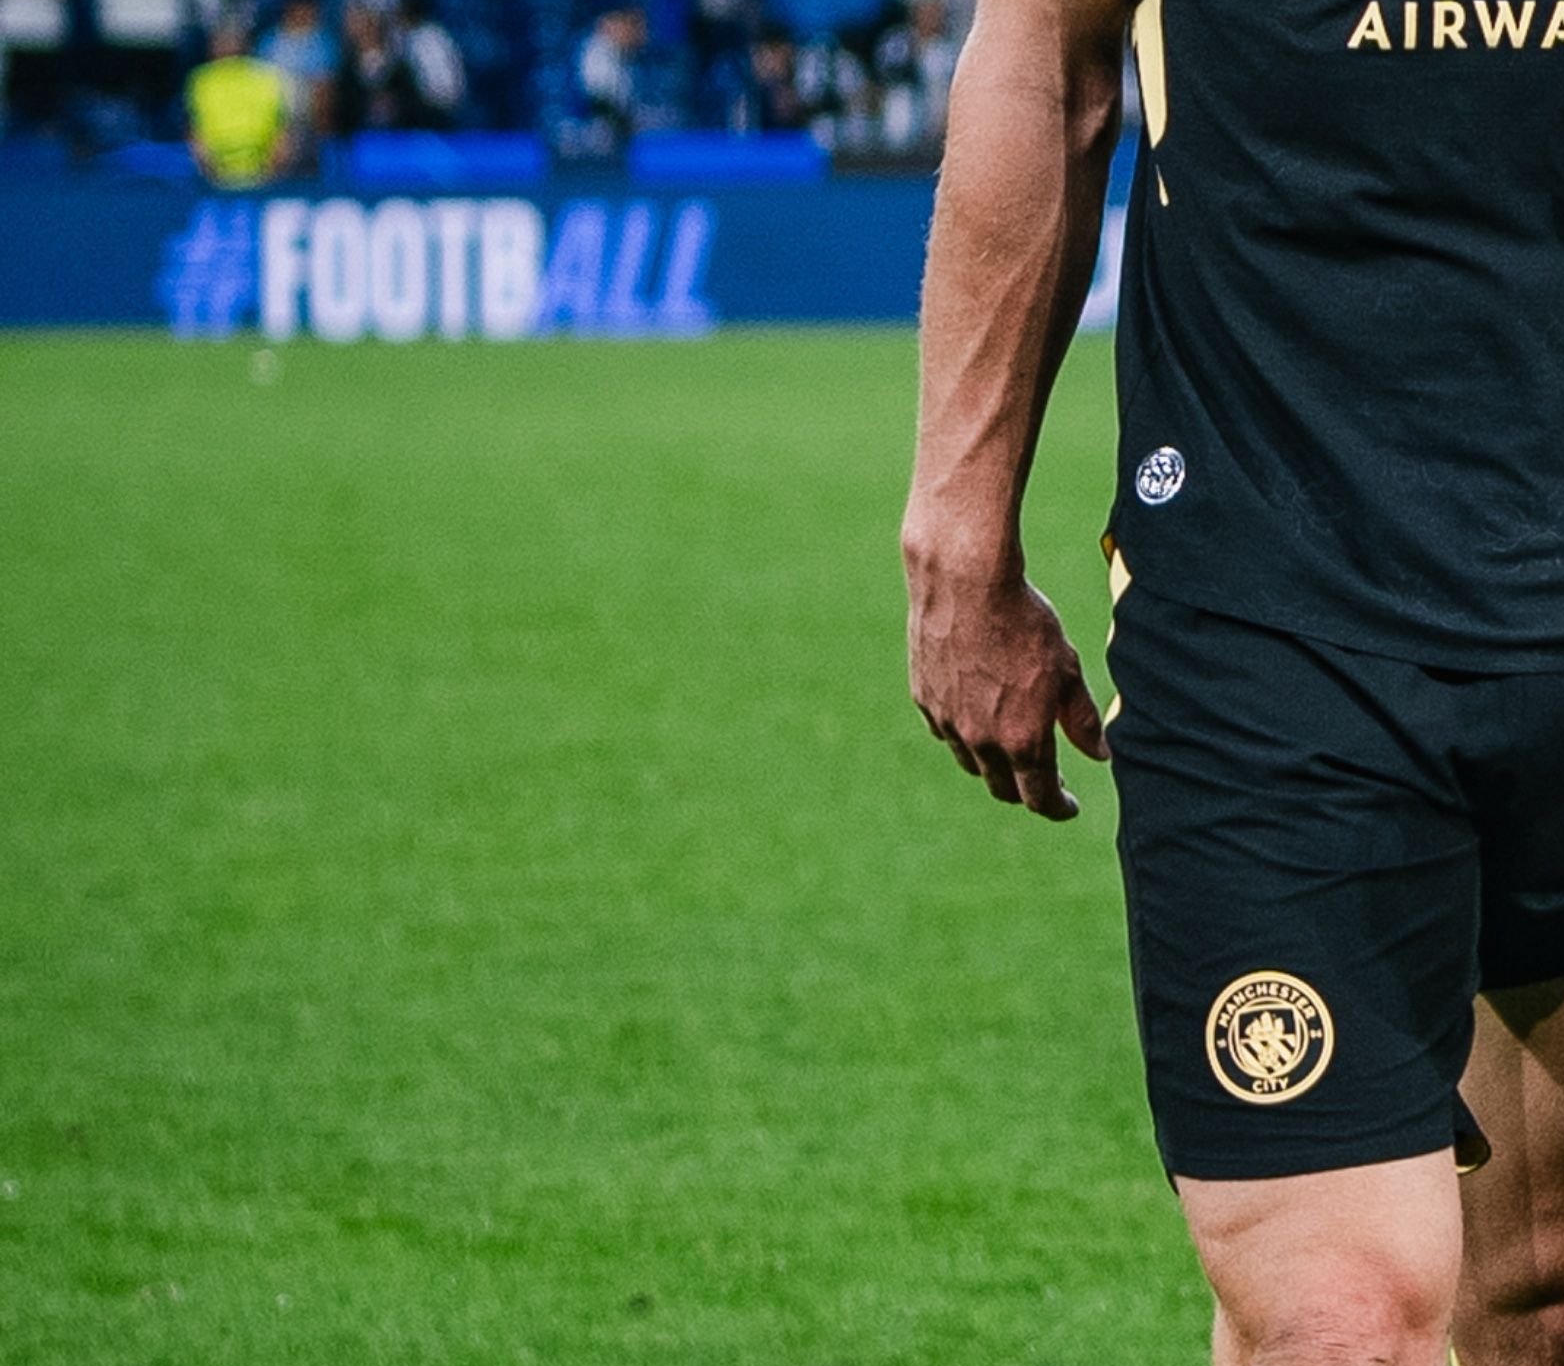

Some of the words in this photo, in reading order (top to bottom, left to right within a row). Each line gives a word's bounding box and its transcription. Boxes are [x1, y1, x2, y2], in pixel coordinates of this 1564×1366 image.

[157, 197, 716, 340] #FOOTBALL
[1218, 982, 1316, 1028] MANCHESTER
[1252, 1077, 1289, 1093] CITY
